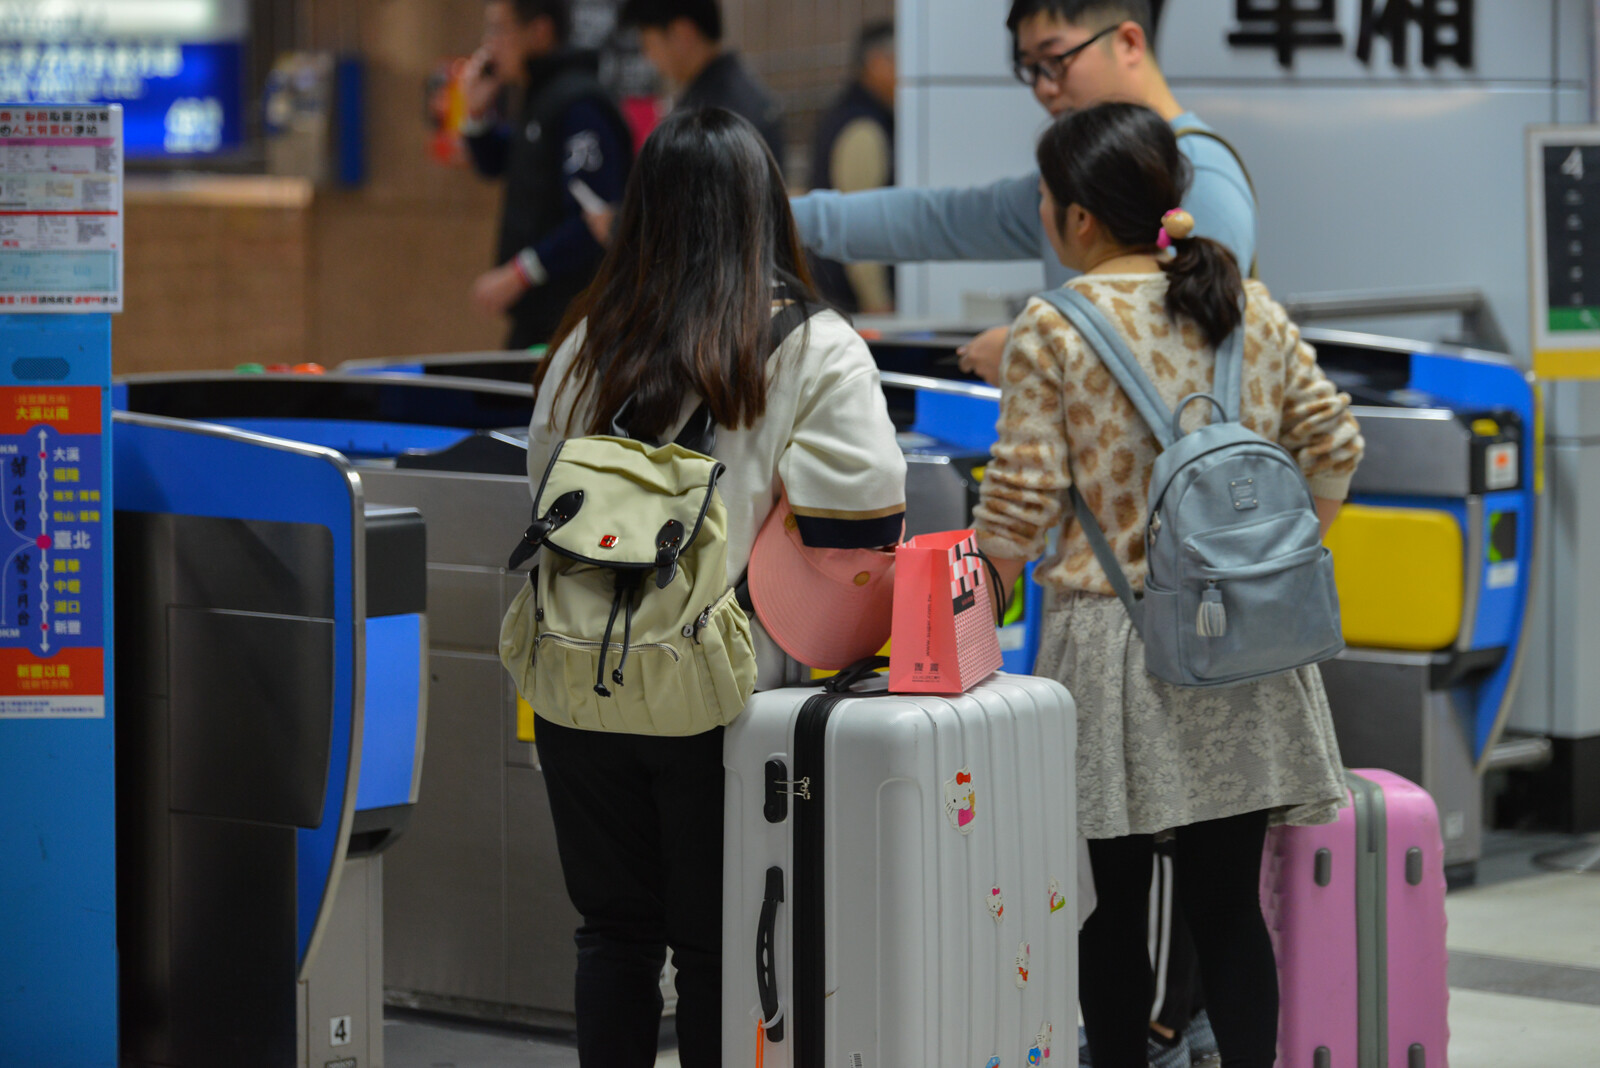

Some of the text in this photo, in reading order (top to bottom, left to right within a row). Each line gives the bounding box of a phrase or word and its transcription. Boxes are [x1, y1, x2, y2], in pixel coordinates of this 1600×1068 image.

[1561, 146, 1584, 181] 4
[53, 447, 79, 461] 大溪
[53, 530, 92, 550] 臺北
[54, 600, 80, 614] 湖口
[335, 1019, 347, 1042] 4
